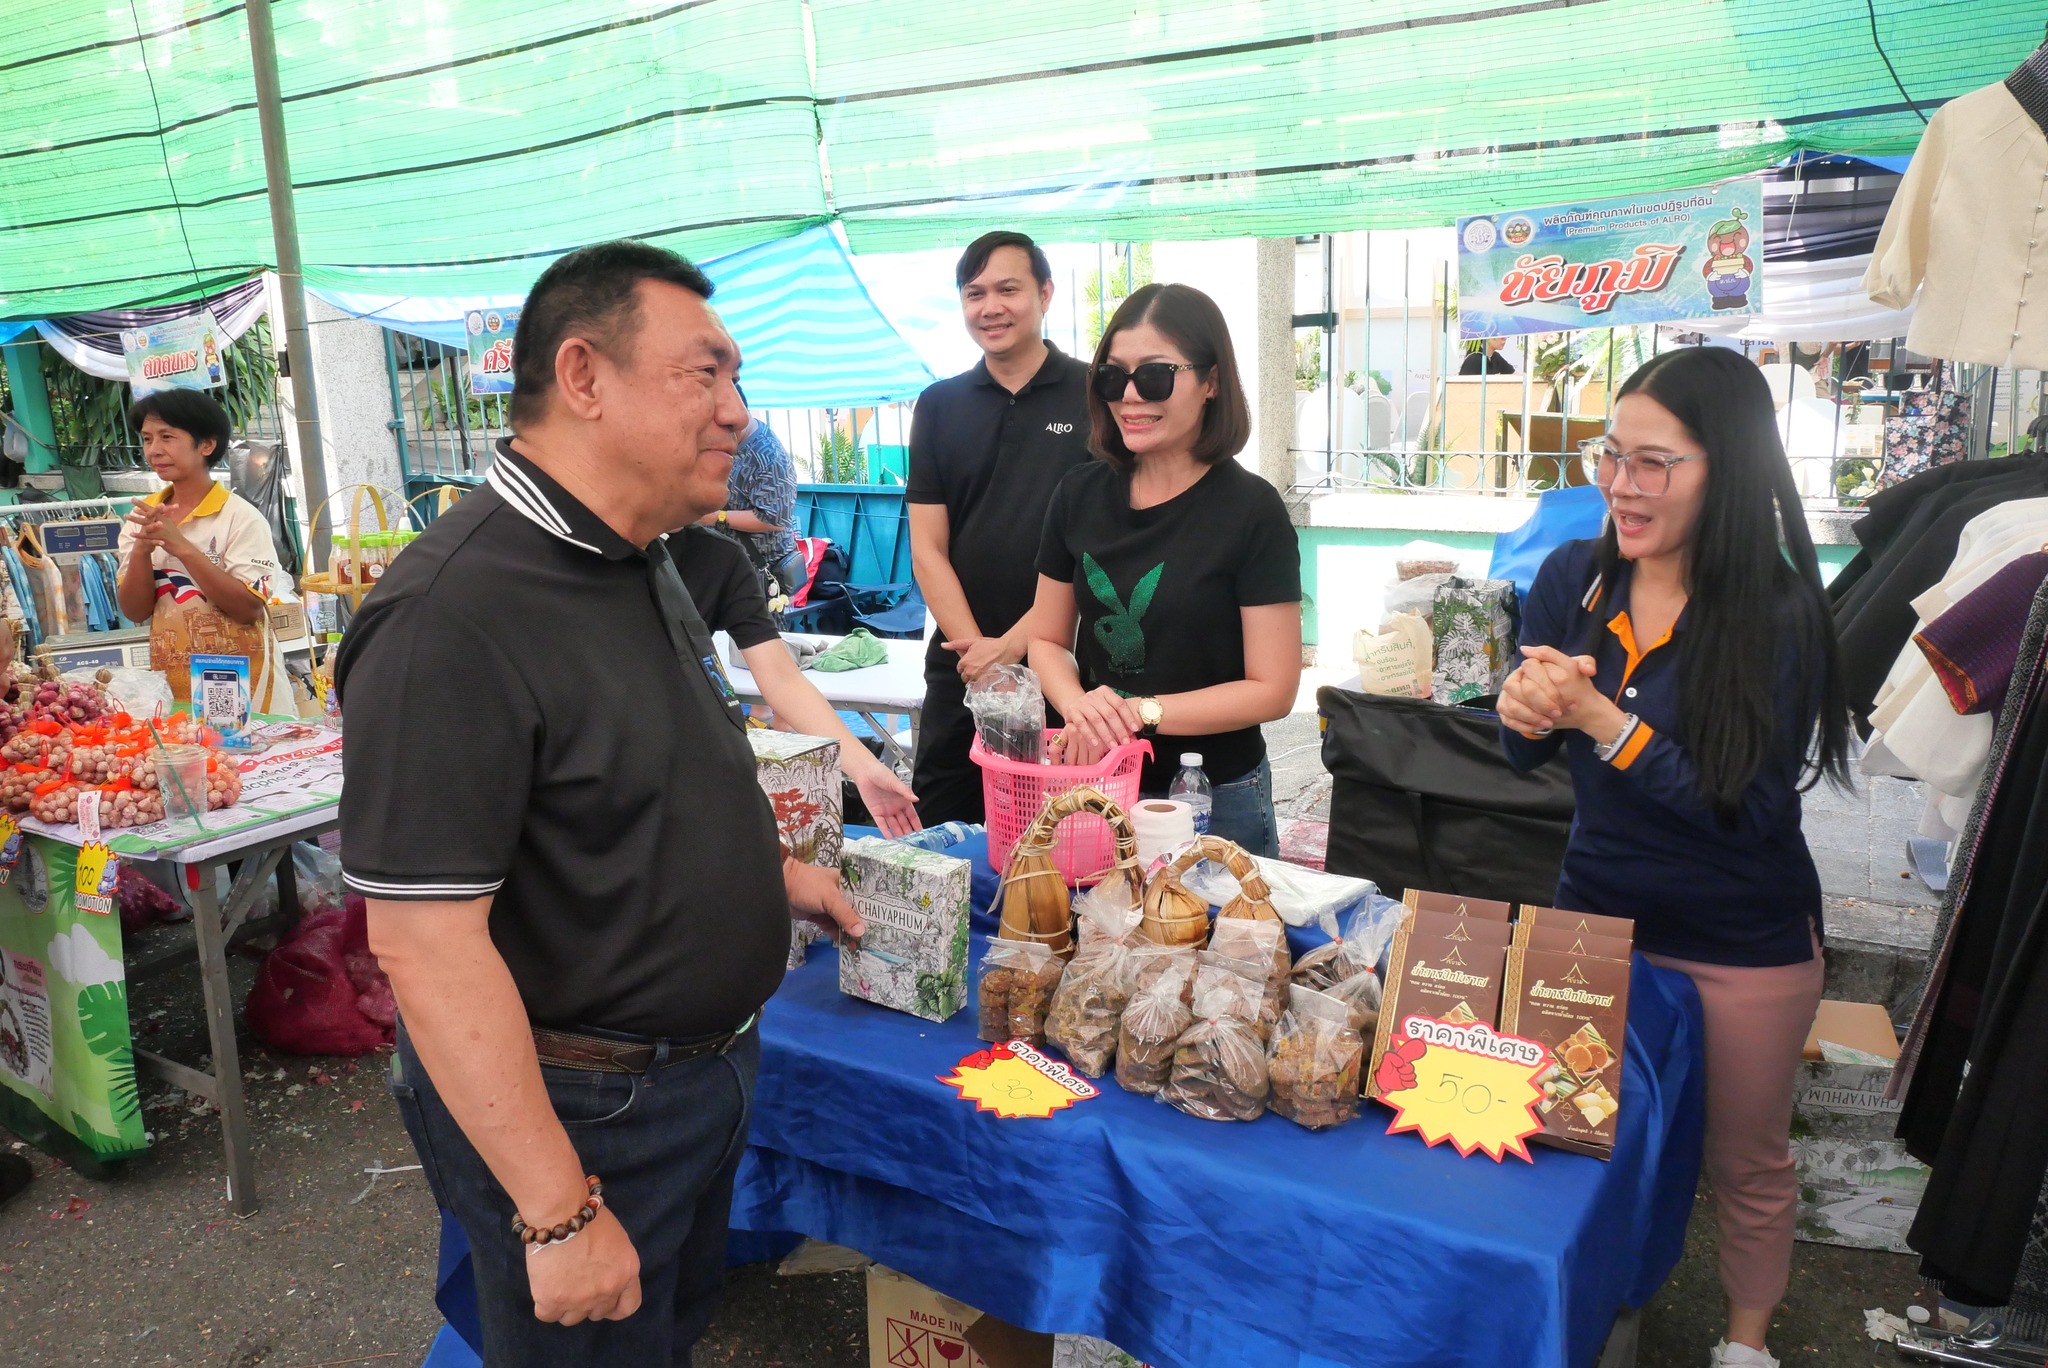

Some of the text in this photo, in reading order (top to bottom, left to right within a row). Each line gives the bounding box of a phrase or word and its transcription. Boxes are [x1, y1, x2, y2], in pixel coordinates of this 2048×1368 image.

[1544, 195, 1713, 226] ผลิตภัณฑ์คุณภาพในเขตปฏิรูปที่ดิน
[1566, 225, 1606, 236] (Premium
[1609, 219, 1647, 230] Products
[1662, 213, 1690, 224] ALRO)
[1500, 244, 1682, 312] ชัยภูมิ
[143, 349, 198, 377] สกลนคร
[483, 338, 514, 371] ศรี
[1045, 422, 1073, 434] ALRO
[75, 893, 112, 912] OMOTION
[857, 900, 923, 932] CHAIYAPHUM
[1409, 1021, 1539, 1062] ราคาพิเศษ
[1011, 1042, 1092, 1094] ราคาพิเศษ
[910, 1309, 962, 1333] MADE IN
